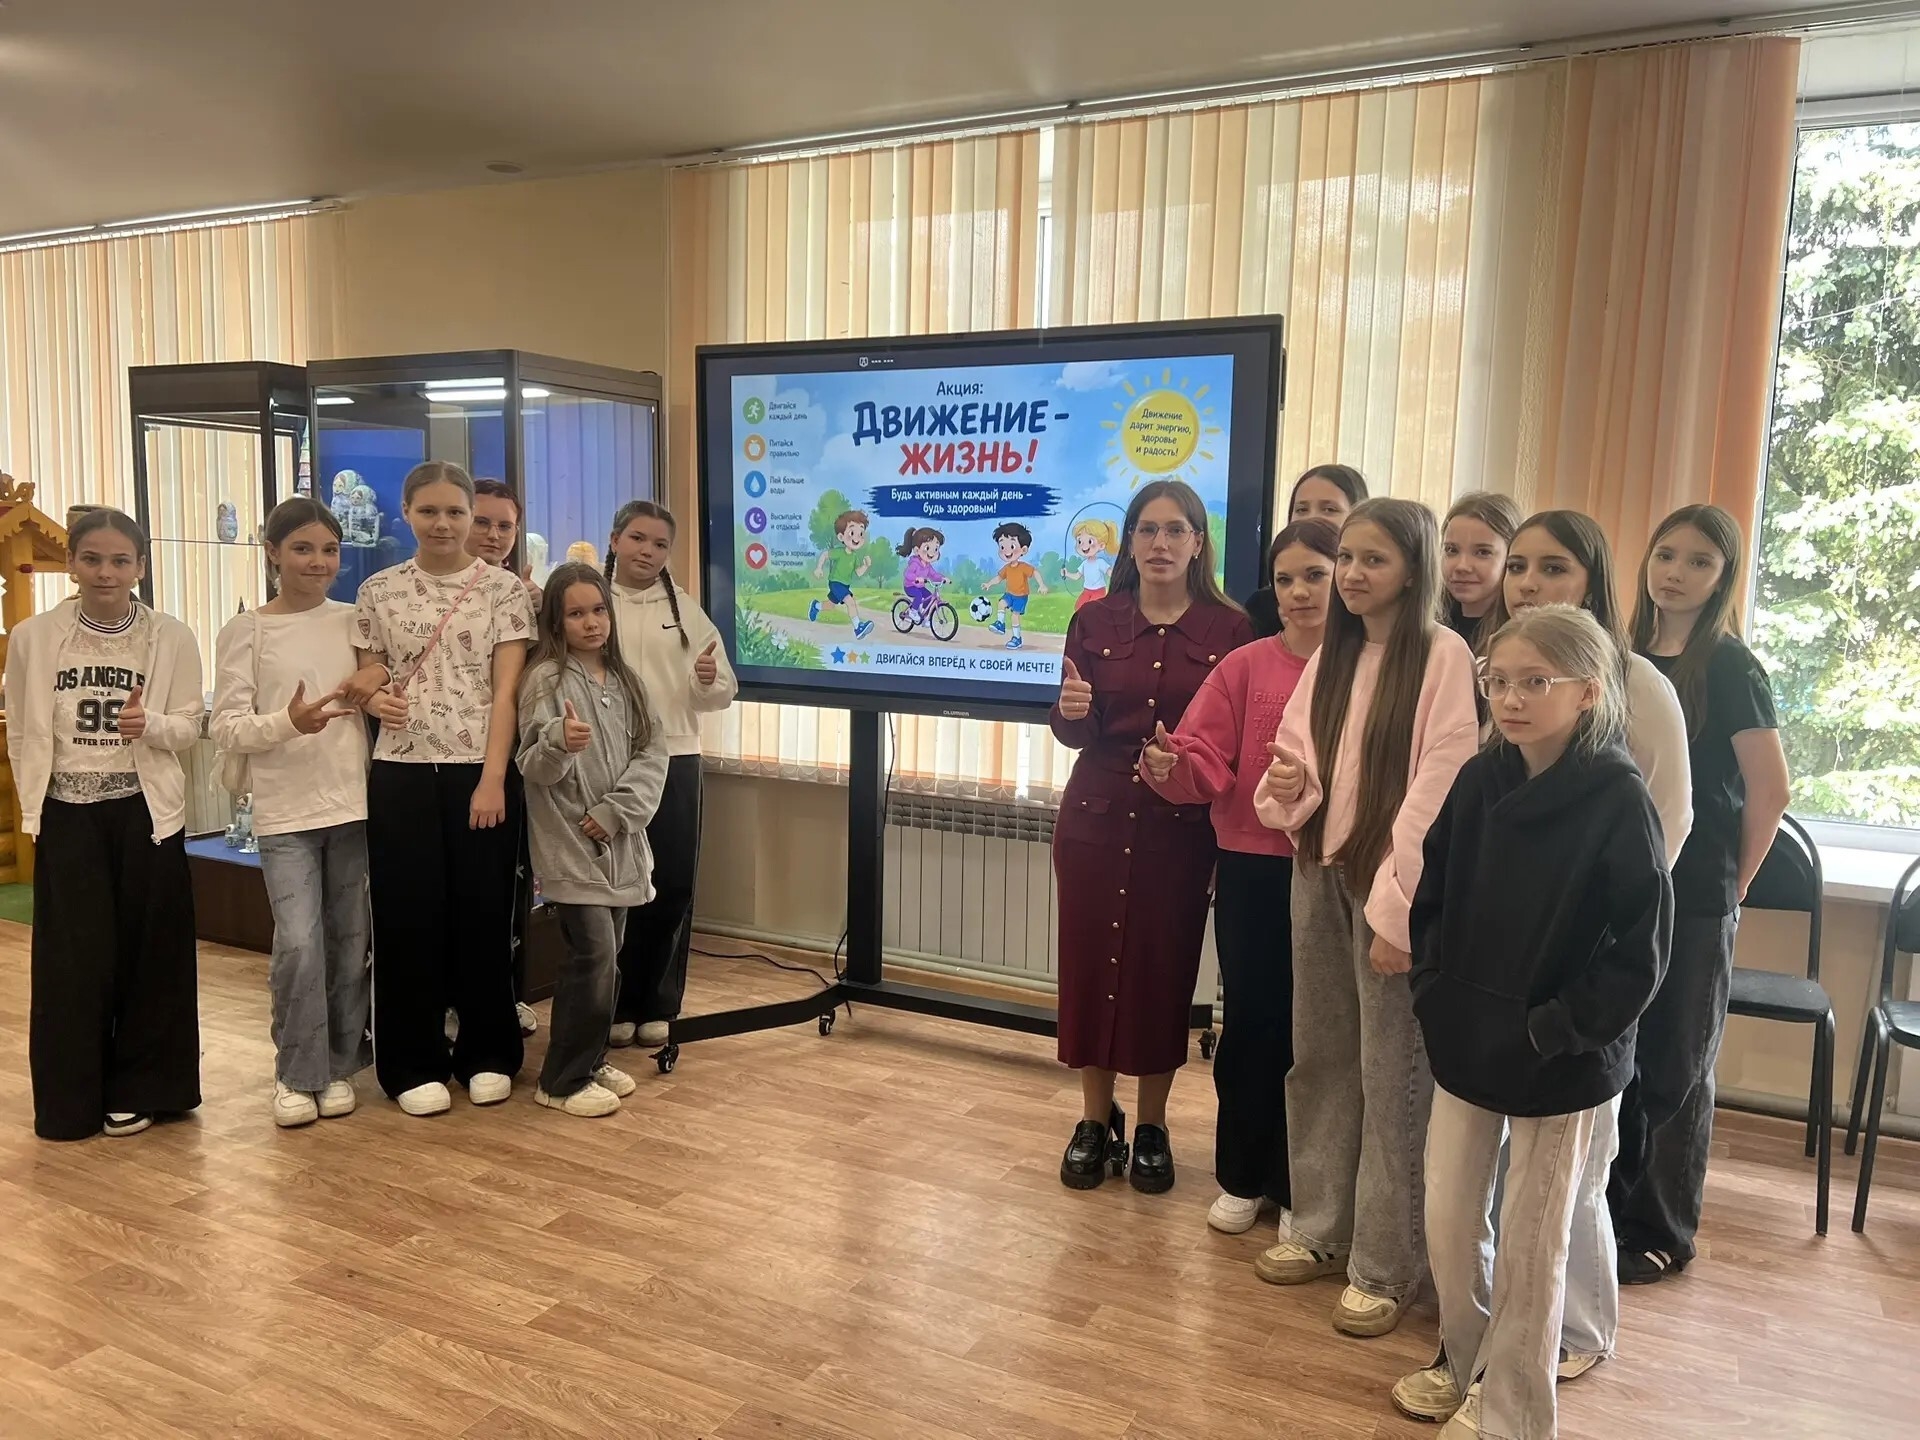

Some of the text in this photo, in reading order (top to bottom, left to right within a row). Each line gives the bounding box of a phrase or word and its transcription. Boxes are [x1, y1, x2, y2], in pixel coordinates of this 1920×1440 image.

[936, 381, 983, 397] Акция:
[769, 401, 796, 410] Двигайся
[769, 412, 808, 421] каждый день
[1142, 408, 1183, 420] Движение
[1130, 422, 1191, 435] дарит энергию,
[769, 439, 794, 447] Питайся
[1141, 435, 1177, 444] здоровье
[769, 451, 800, 459] правильно
[1144, 447, 1178, 456] радость!
[898, 438, 1039, 476] ЖИЗНЬ!
[782, 475, 805, 485] больше
[769, 487, 785, 495] воды
[890, 488, 912, 502] Будь
[914, 489, 960, 501] активным
[962, 488, 999, 501] каждый
[1001, 490, 1024, 501] день
[923, 501, 997, 515] будь здоровым!
[775, 523, 801, 531] отдыхай
[875, 652, 1055, 674] ДВИГАЙСЯ ВПЕРЁД К СВОЕЙ МЕЧТЕ!
[54, 668, 78, 691] OS
[76, 699, 127, 733] 99
[72, 737, 133, 747] NEVER GIVE UP
